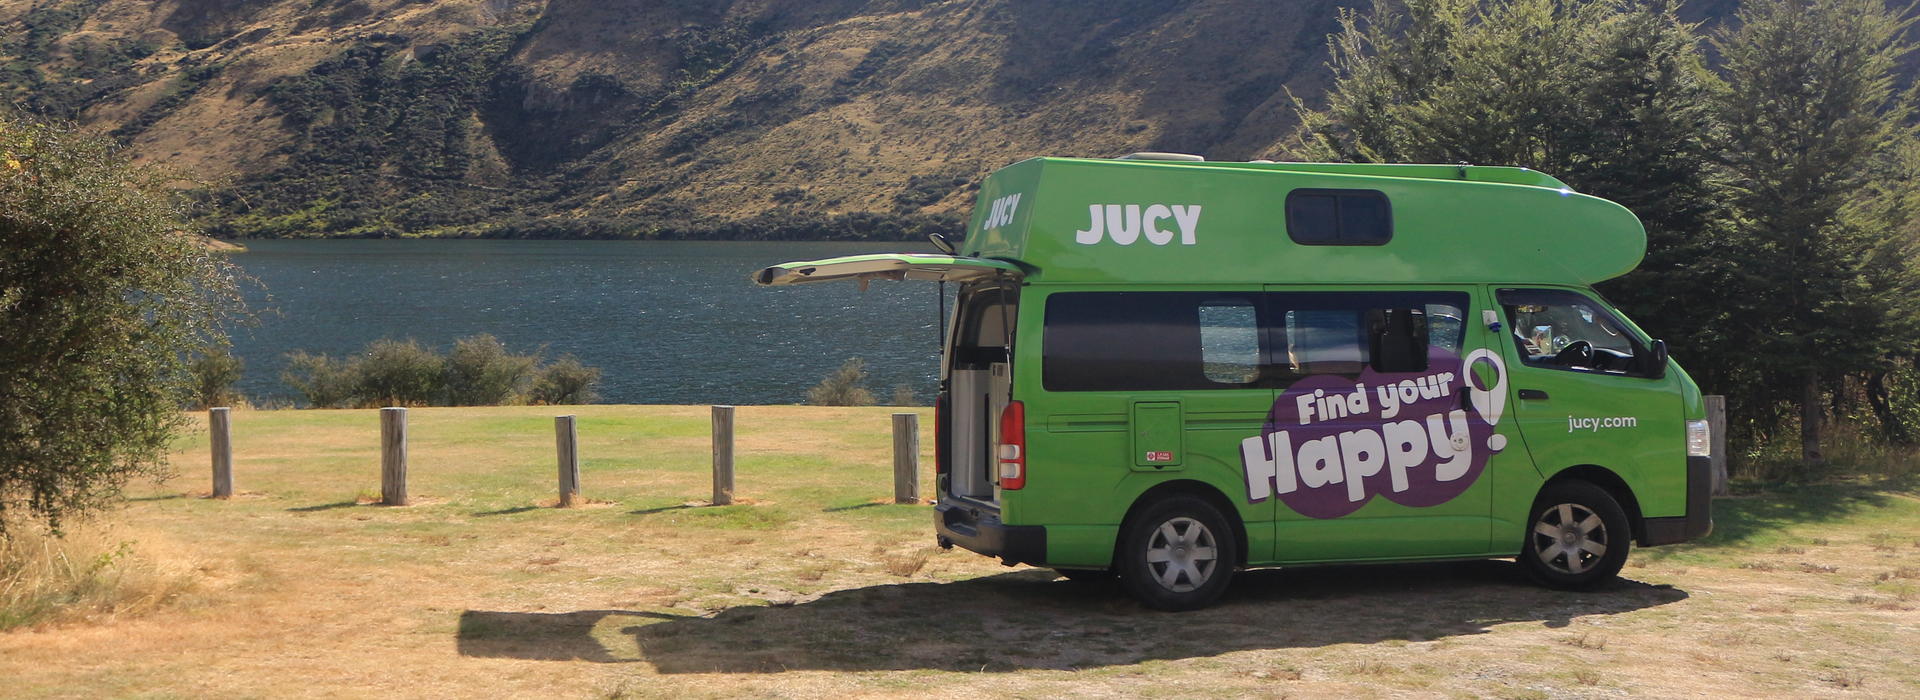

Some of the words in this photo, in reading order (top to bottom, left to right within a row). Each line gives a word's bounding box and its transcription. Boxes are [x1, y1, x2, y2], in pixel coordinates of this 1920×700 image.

[984, 193, 1021, 230] JUCY
[1076, 204, 1201, 245] JUCY
[1296, 383, 1369, 425] Find
[1377, 372, 1454, 418] your
[1568, 415, 1637, 433] jucy.com
